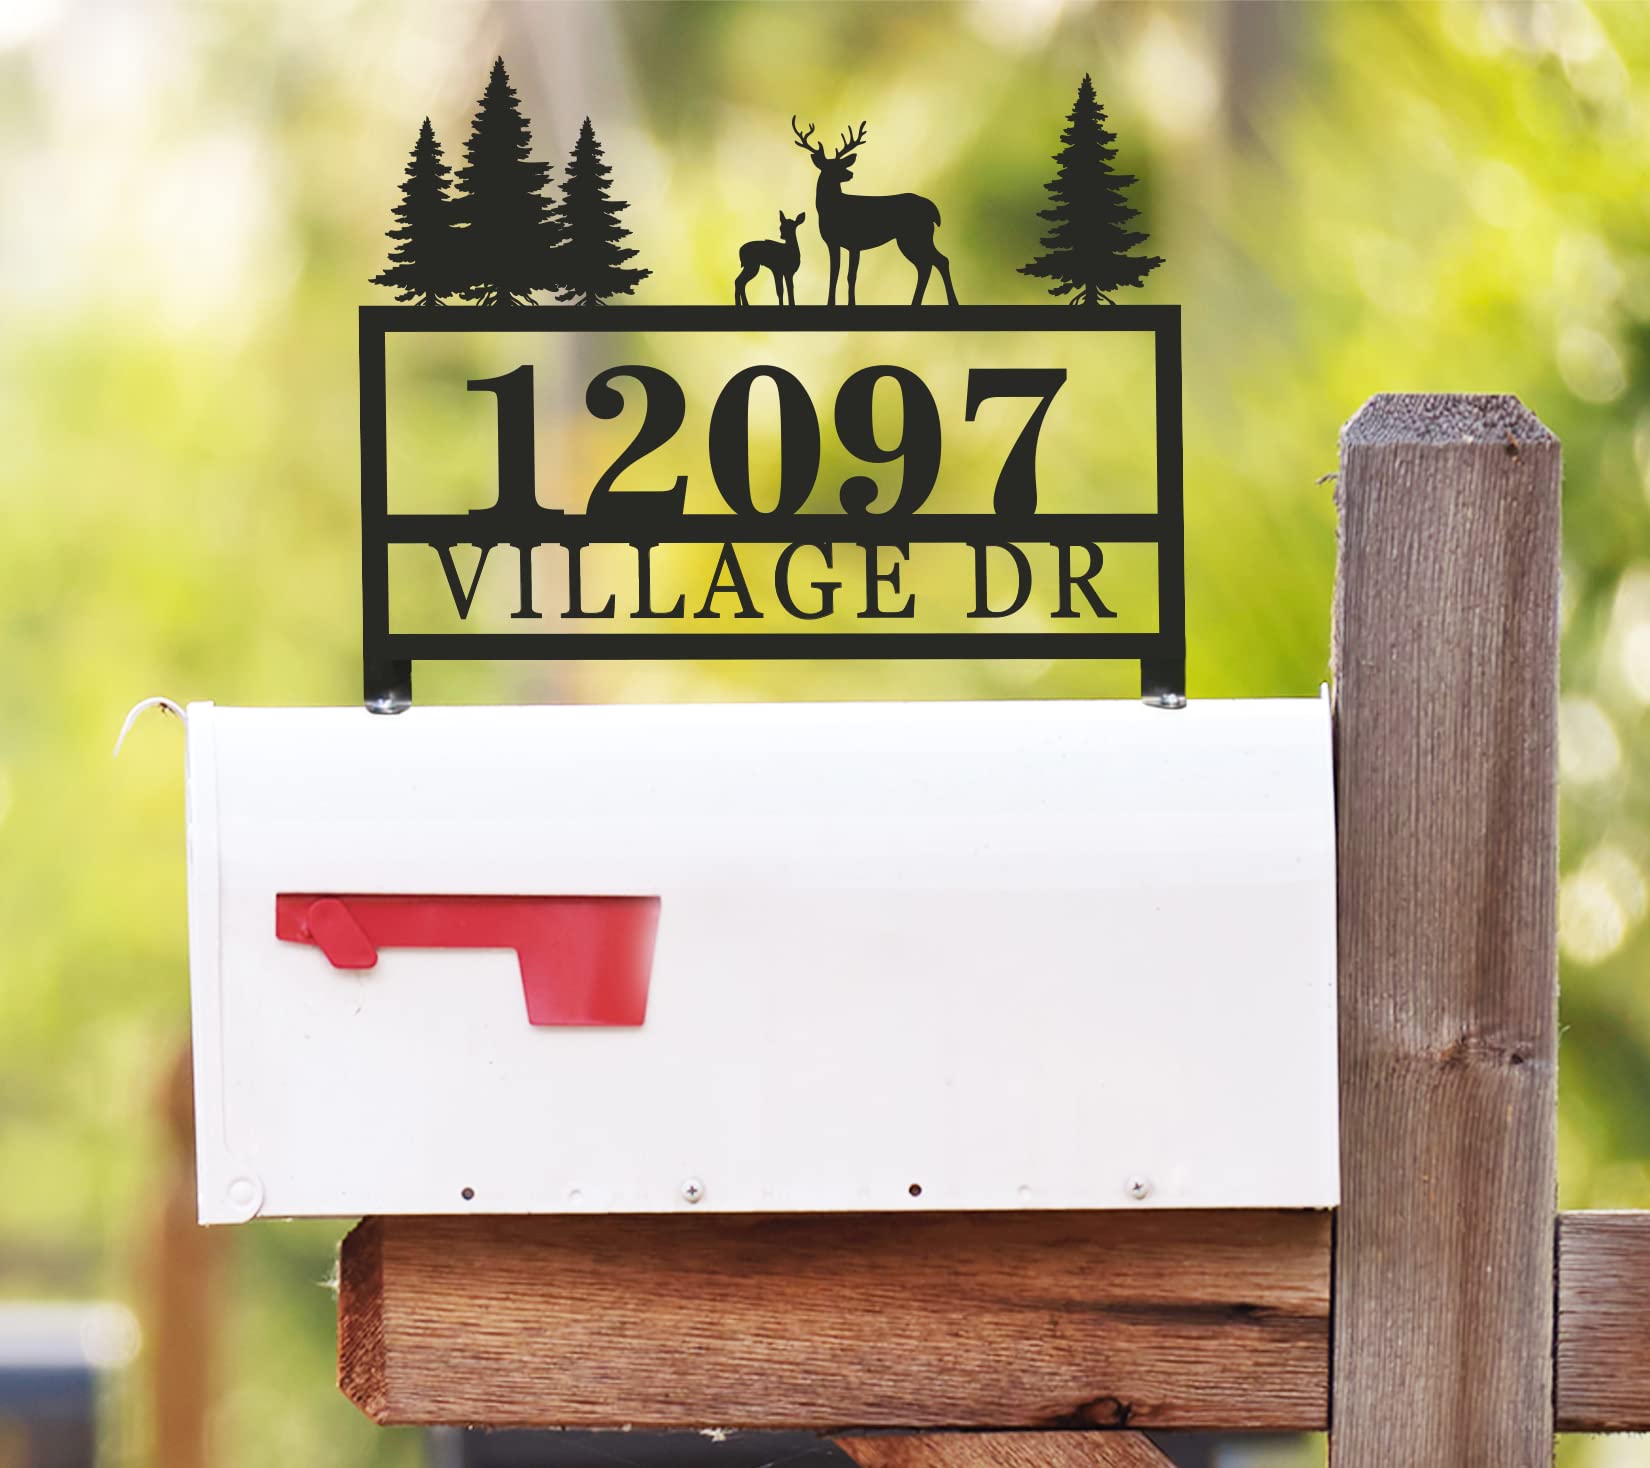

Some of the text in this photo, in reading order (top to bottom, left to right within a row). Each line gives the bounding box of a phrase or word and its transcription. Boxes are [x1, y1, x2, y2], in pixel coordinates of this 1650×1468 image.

[466, 364, 1068, 517] 12097
[428, 541, 1118, 620] VILLAGE DR
